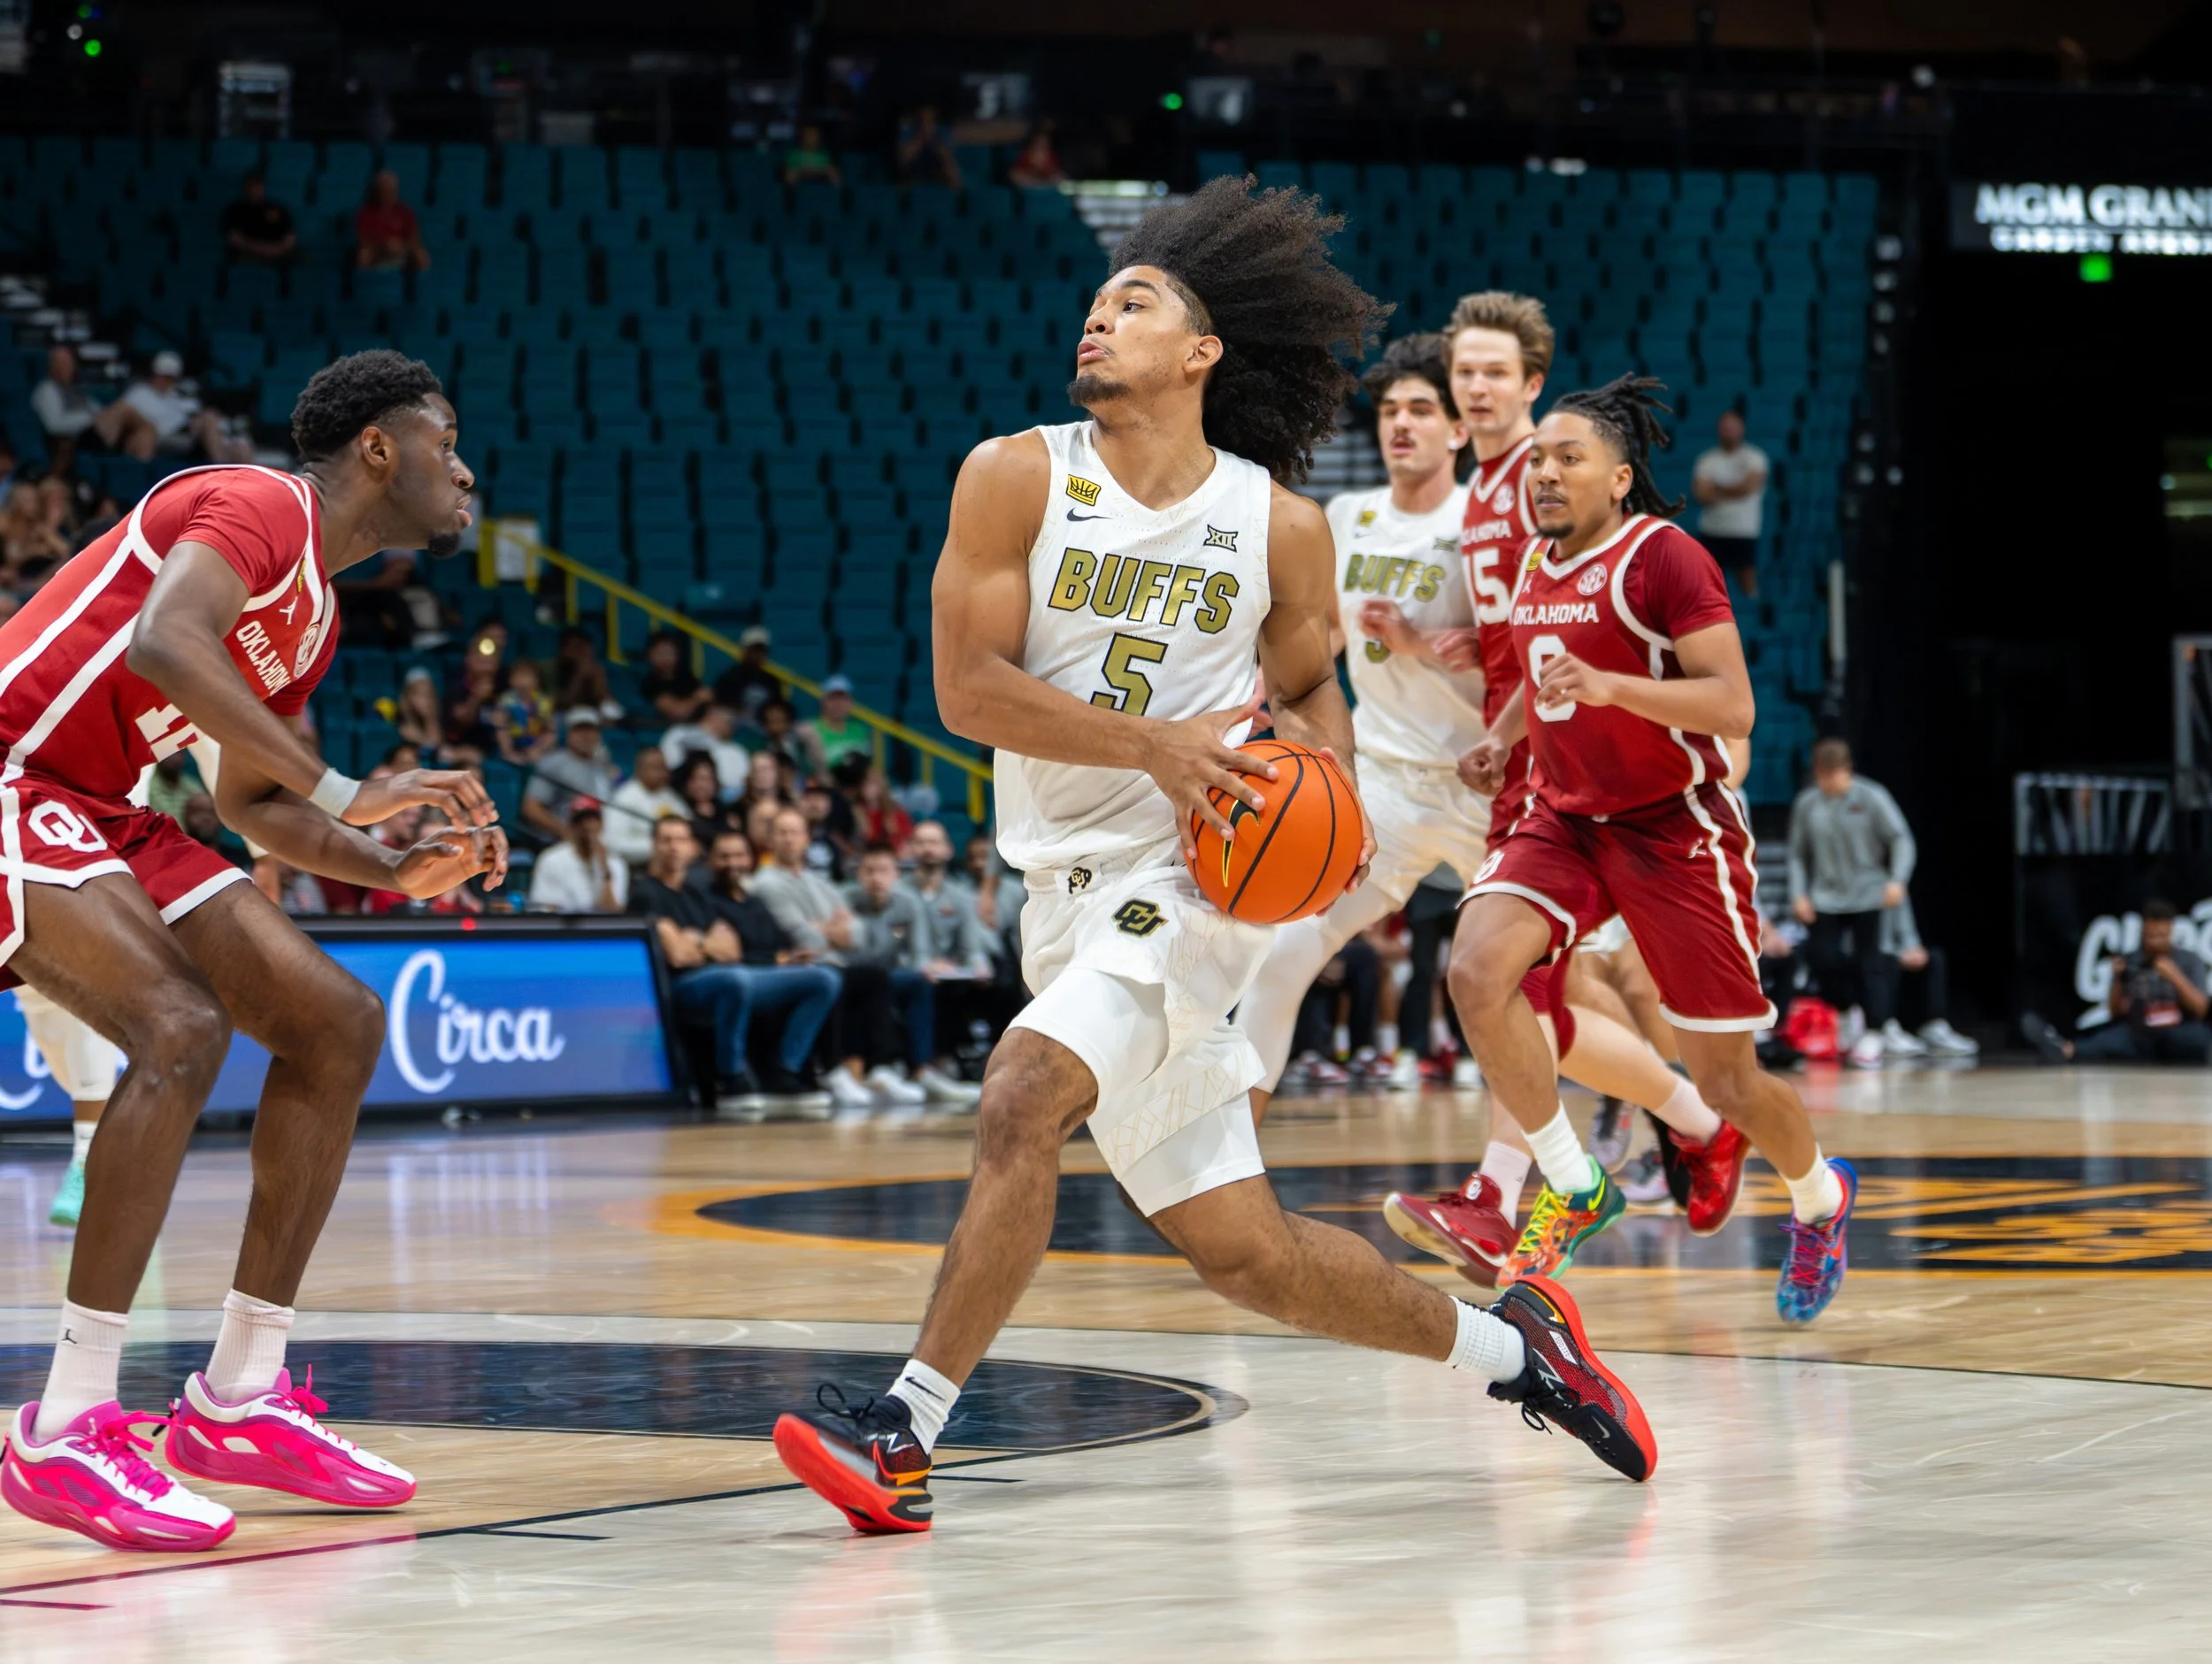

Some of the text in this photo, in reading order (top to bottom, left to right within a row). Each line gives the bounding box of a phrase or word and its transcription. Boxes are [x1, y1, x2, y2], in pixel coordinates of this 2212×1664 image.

[1975, 182, 2212, 226] MGM GRAN
[1048, 547, 1240, 634] BUFFS
[1343, 554, 1446, 602] BUFFS
[1513, 602, 1600, 625] OKLAHOMA
[236, 620, 291, 697] OKLAHOM
[1089, 632, 1169, 718] 5
[27, 800, 109, 861] OU
[389, 948, 566, 1094] Circa
